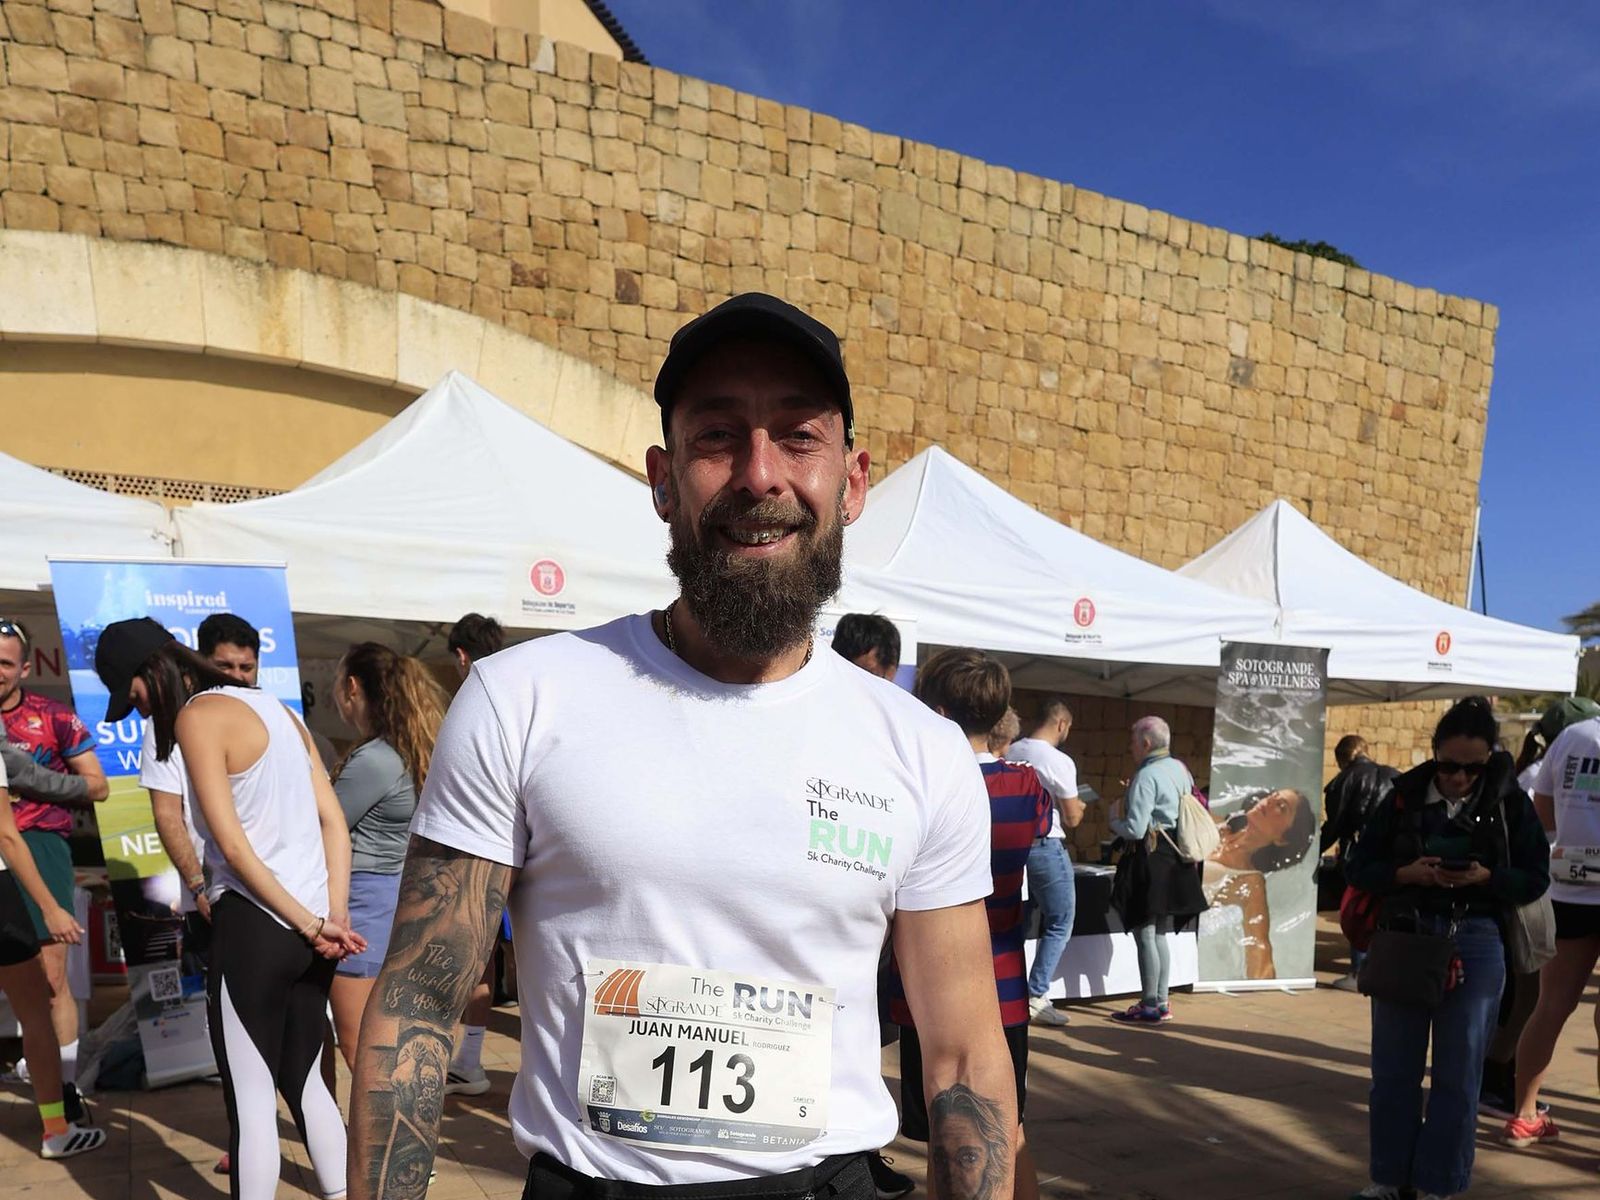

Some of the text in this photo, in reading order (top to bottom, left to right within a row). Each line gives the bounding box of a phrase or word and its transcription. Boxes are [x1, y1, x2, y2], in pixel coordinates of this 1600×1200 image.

[145, 590, 227, 611] inspired
[1228, 671, 1249, 686] SPA
[1260, 673, 1320, 689] WELLNESS
[1235, 659, 1315, 676] SOTOGRANDE
[806, 799, 838, 820] The
[809, 819, 893, 868] RUN
[807, 851, 887, 881] 5k Charity Challenge
[425, 943, 453, 969] The
[408, 968, 460, 993] world
[386, 980, 404, 1008] is
[691, 977, 813, 1020] The RUN
[744, 1012, 773, 1025] Charity
[775, 1017, 812, 1031] Challenge
[629, 1020, 791, 1052] JUAN MANUEL RODRIGUEZ
[652, 1046, 756, 1114] 113
[798, 1105, 807, 1118] S
[762, 1135, 806, 1145] BETANIA
